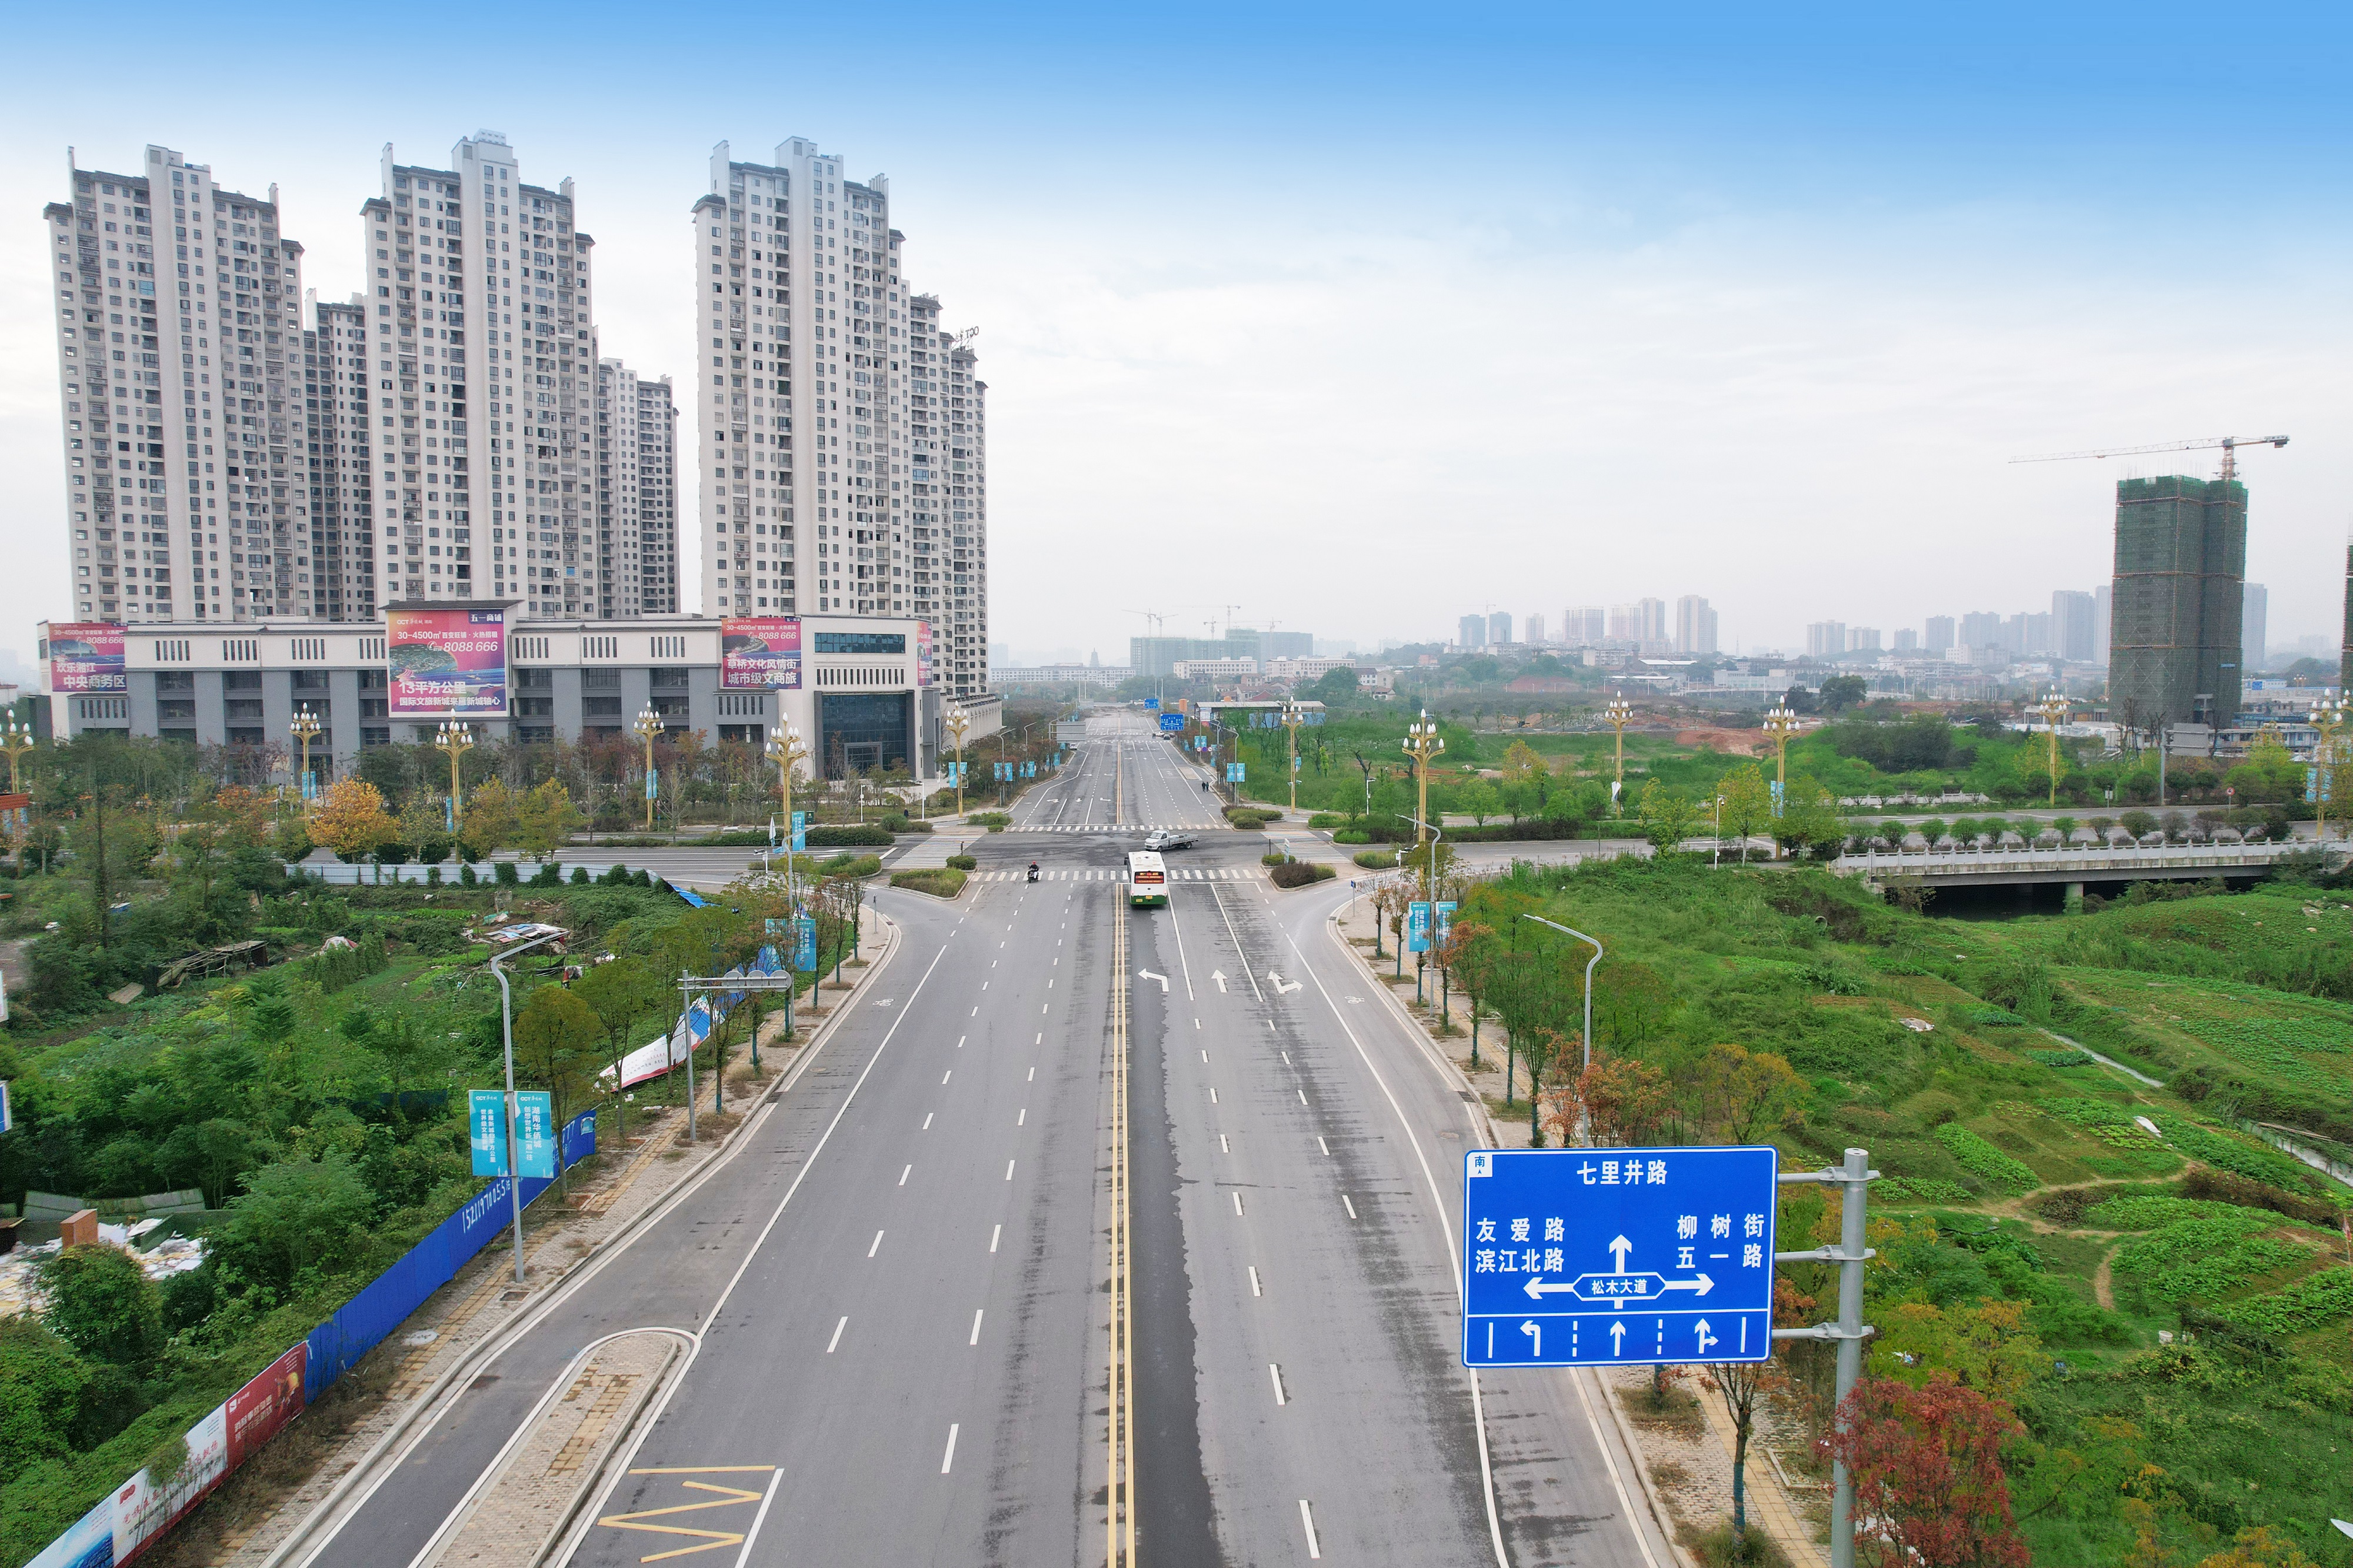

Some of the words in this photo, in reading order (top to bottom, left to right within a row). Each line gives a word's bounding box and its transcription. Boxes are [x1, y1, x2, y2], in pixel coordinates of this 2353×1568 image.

[471, 613, 502, 622] 五一商铺
[443, 642, 473, 652] 8088
[475, 641, 498, 652] 666
[56, 662, 96, 673] 欢乐湘江
[727, 658, 796, 670] 草桥文化风情街
[63, 675, 126, 689] 中央商务区
[728, 672, 796, 685] 城市级文商旅
[399, 681, 467, 695] 13平方公里
[532, 1106, 542, 1148] 湖南华侨城
[1474, 1156, 1485, 1167] 南
[1577, 1159, 1668, 1186] 七里井路
[1475, 1217, 1565, 1243] 友爱路
[1677, 1213, 1765, 1239] 柳树街
[1475, 1248, 1565, 1273] 滨江北路
[1676, 1243, 1763, 1269] 五一路
[1591, 1278, 1647, 1295] 松木大道
